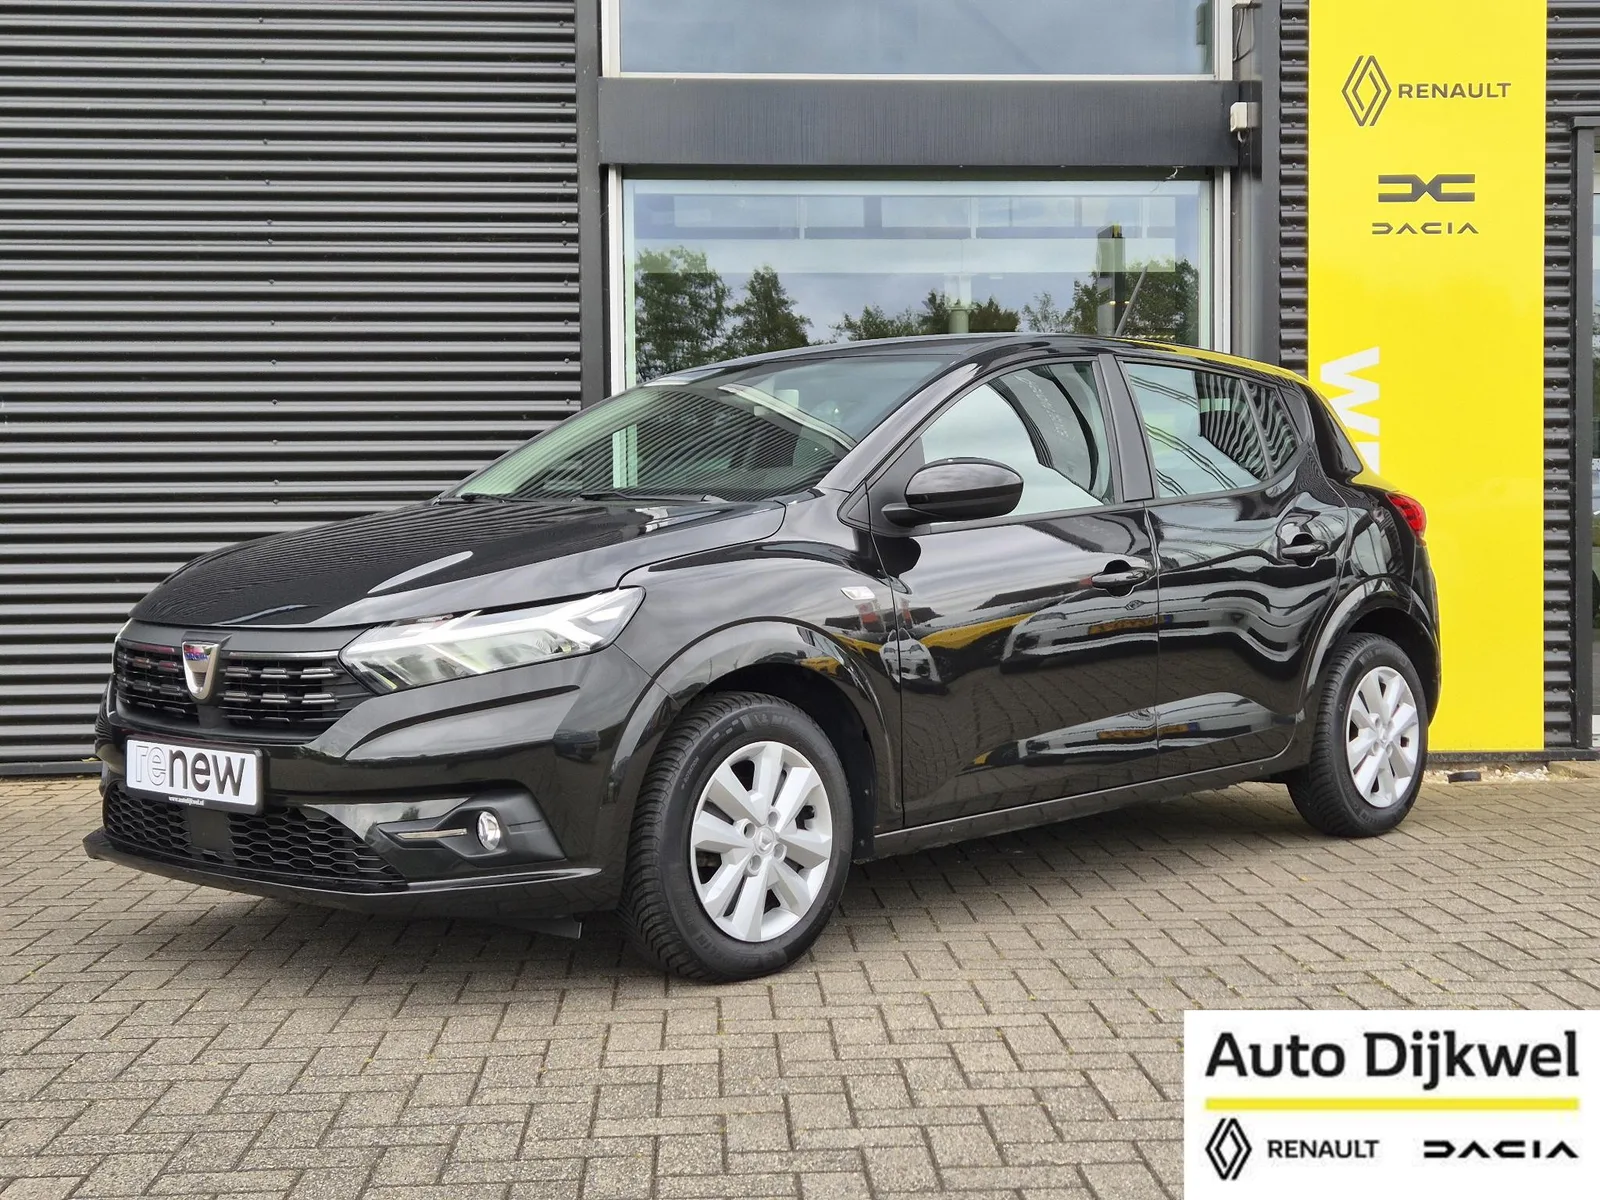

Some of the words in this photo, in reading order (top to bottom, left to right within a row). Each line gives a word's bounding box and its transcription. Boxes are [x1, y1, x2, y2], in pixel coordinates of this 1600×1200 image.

[1398, 82, 1512, 99] RENAULT
[1371, 222, 1479, 235] DACIA
[135, 744, 246, 797] renew
